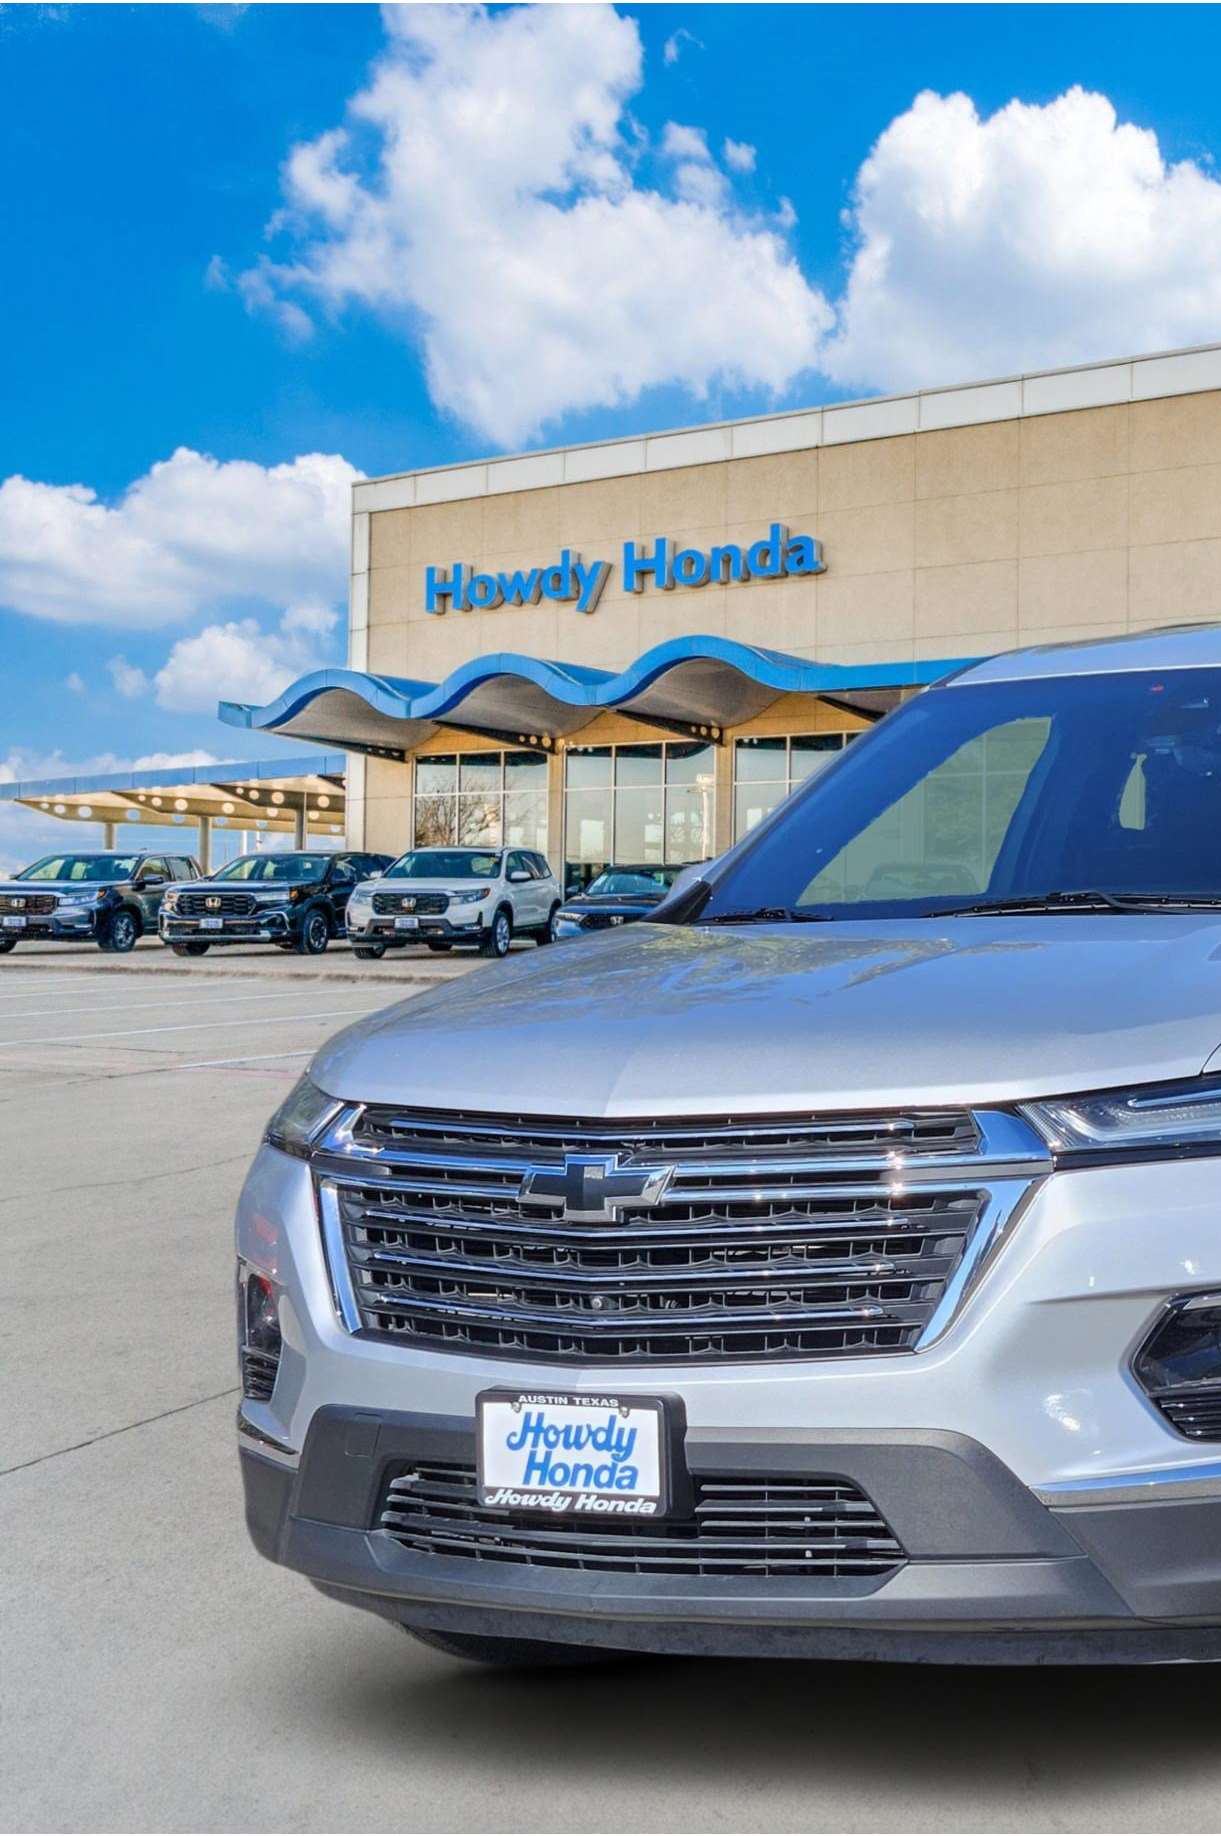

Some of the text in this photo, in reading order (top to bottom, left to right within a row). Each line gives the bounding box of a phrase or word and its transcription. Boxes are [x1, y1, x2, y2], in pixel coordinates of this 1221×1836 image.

[425, 523, 826, 614] Howdy Honda
[518, 1395, 619, 1408] AUSTIN TEXAS
[506, 1412, 638, 1462] Howdy
[522, 1450, 639, 1490] Honda
[485, 1489, 657, 1514] Howdy Honda
